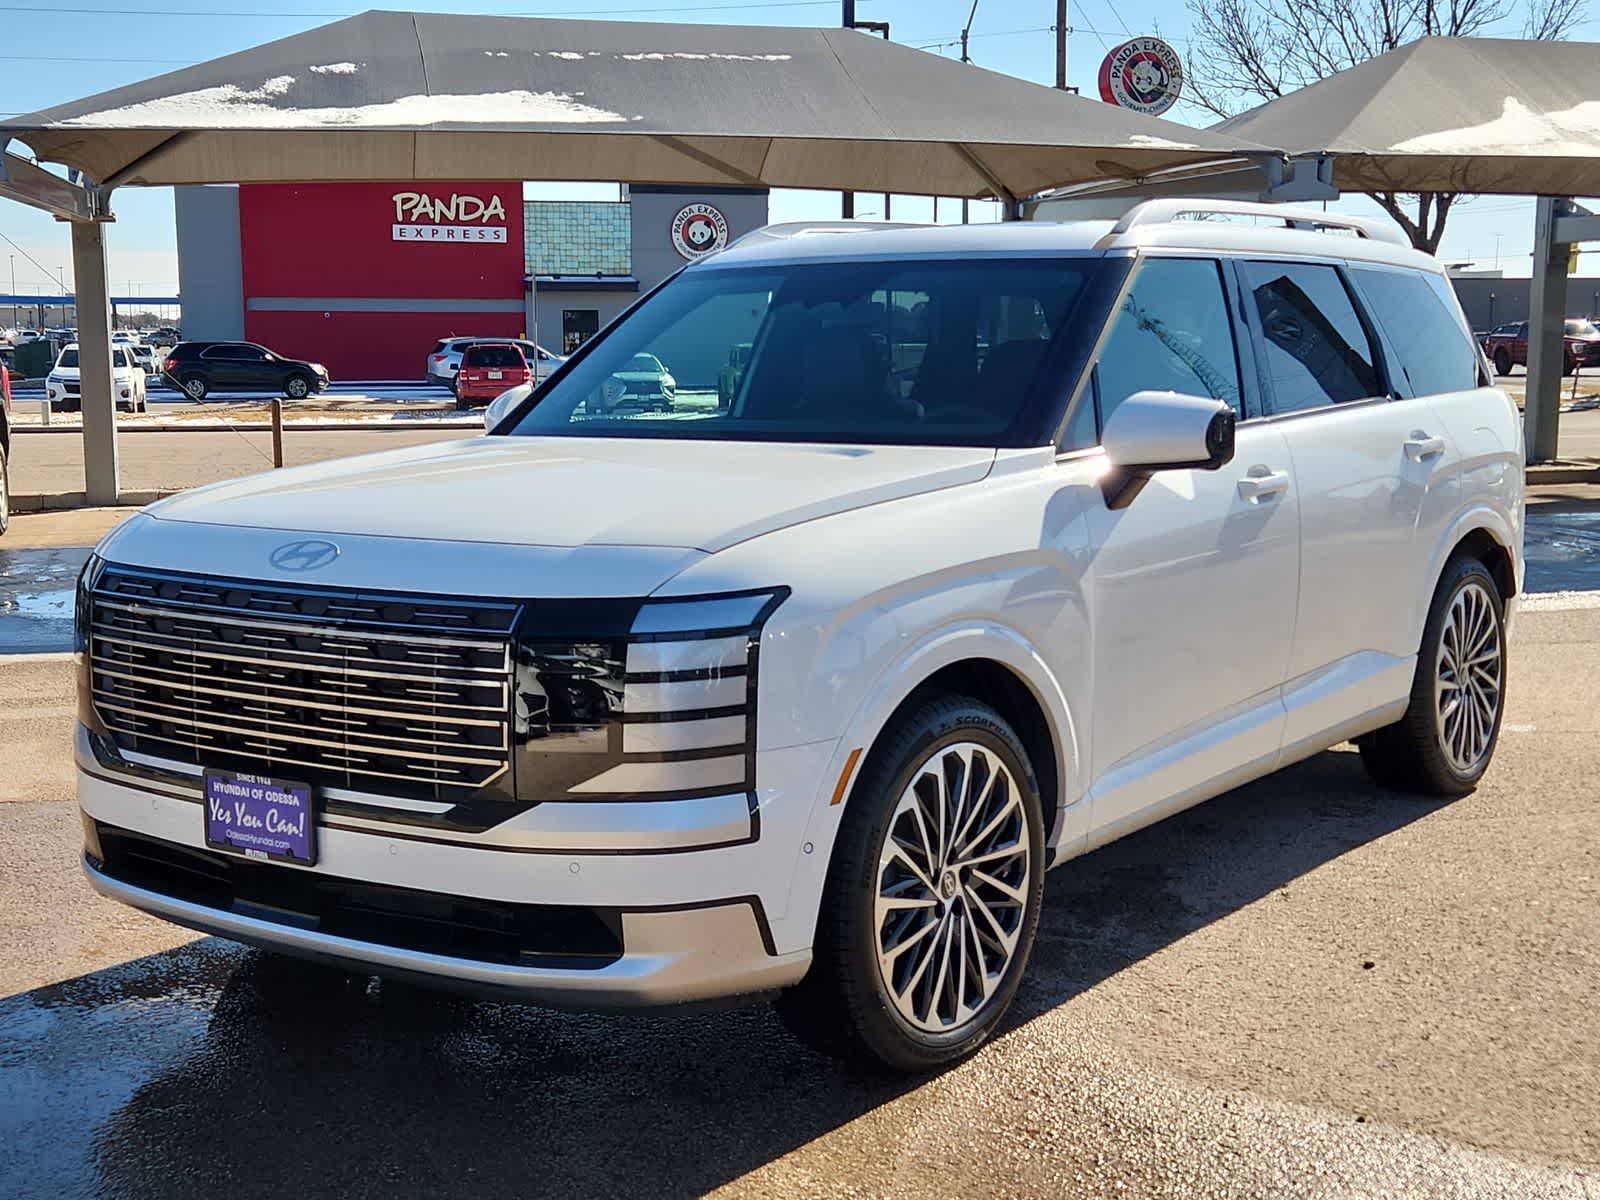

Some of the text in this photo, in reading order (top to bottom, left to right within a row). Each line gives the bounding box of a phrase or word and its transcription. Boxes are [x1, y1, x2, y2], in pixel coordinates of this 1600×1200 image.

[1112, 41, 1179, 79] PANDA EXPRESS
[392, 192, 505, 223] PANDA
[673, 205, 726, 234] PANDA EXPRESS
[399, 227, 501, 240] EXPRESS
[236, 773, 256, 784] SINCE
[213, 781, 300, 807] HYUNDAI OF ODESSA
[209, 797, 305, 838] Yes You Can!
